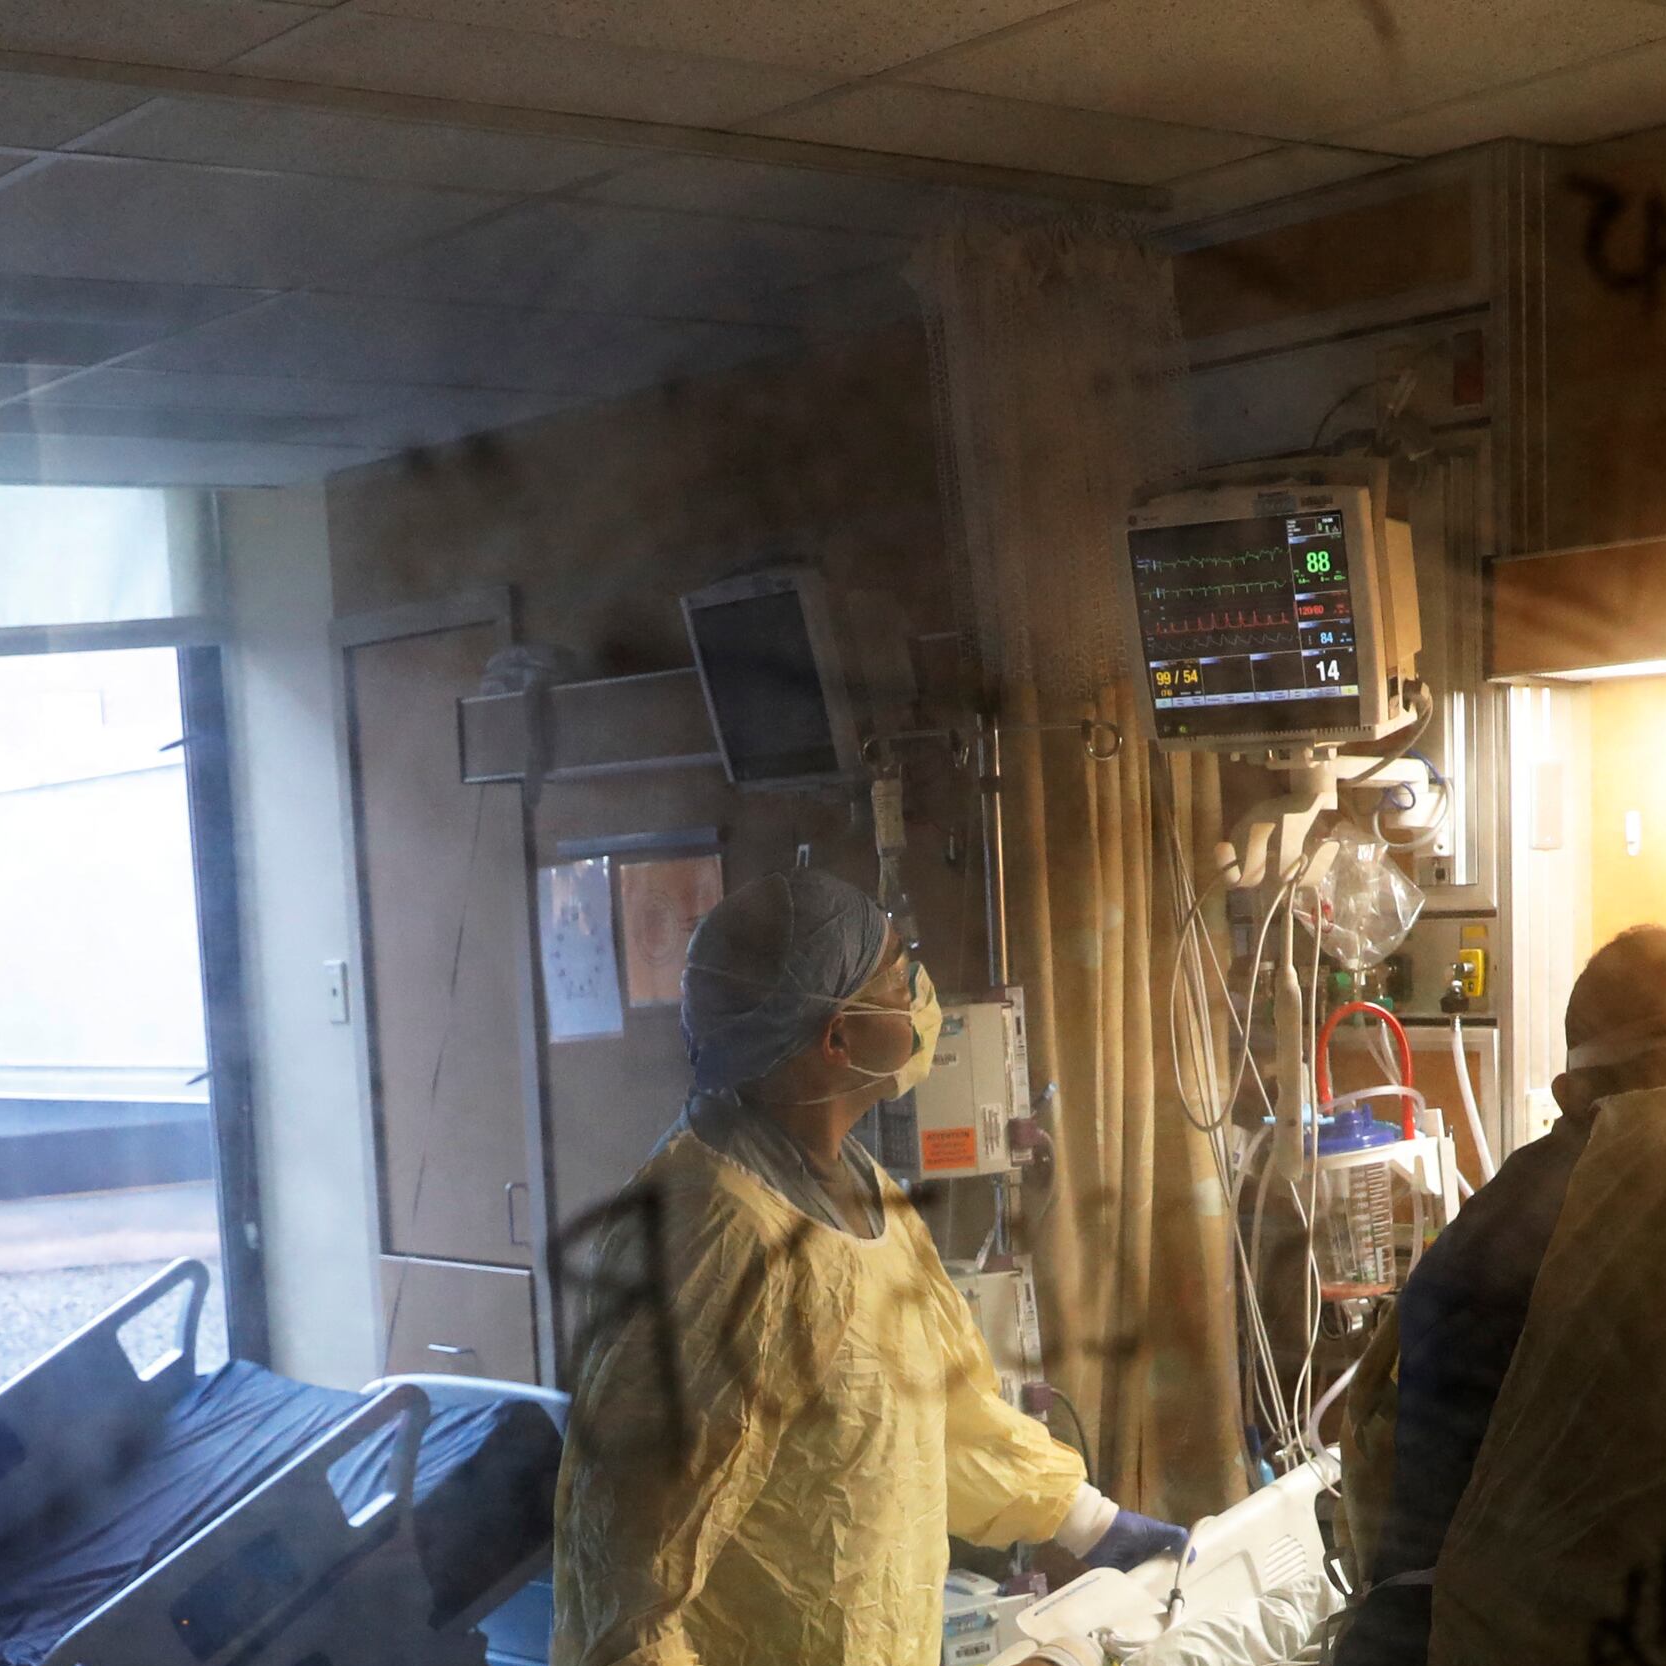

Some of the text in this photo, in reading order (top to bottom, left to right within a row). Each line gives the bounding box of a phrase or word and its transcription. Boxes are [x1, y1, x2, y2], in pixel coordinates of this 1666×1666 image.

[1306, 551, 1331, 573] 88
[1320, 631, 1334, 645] 84
[1156, 671, 1172, 686] 99
[1182, 669, 1199, 684] 54
[1316, 660, 1341, 682] 14
